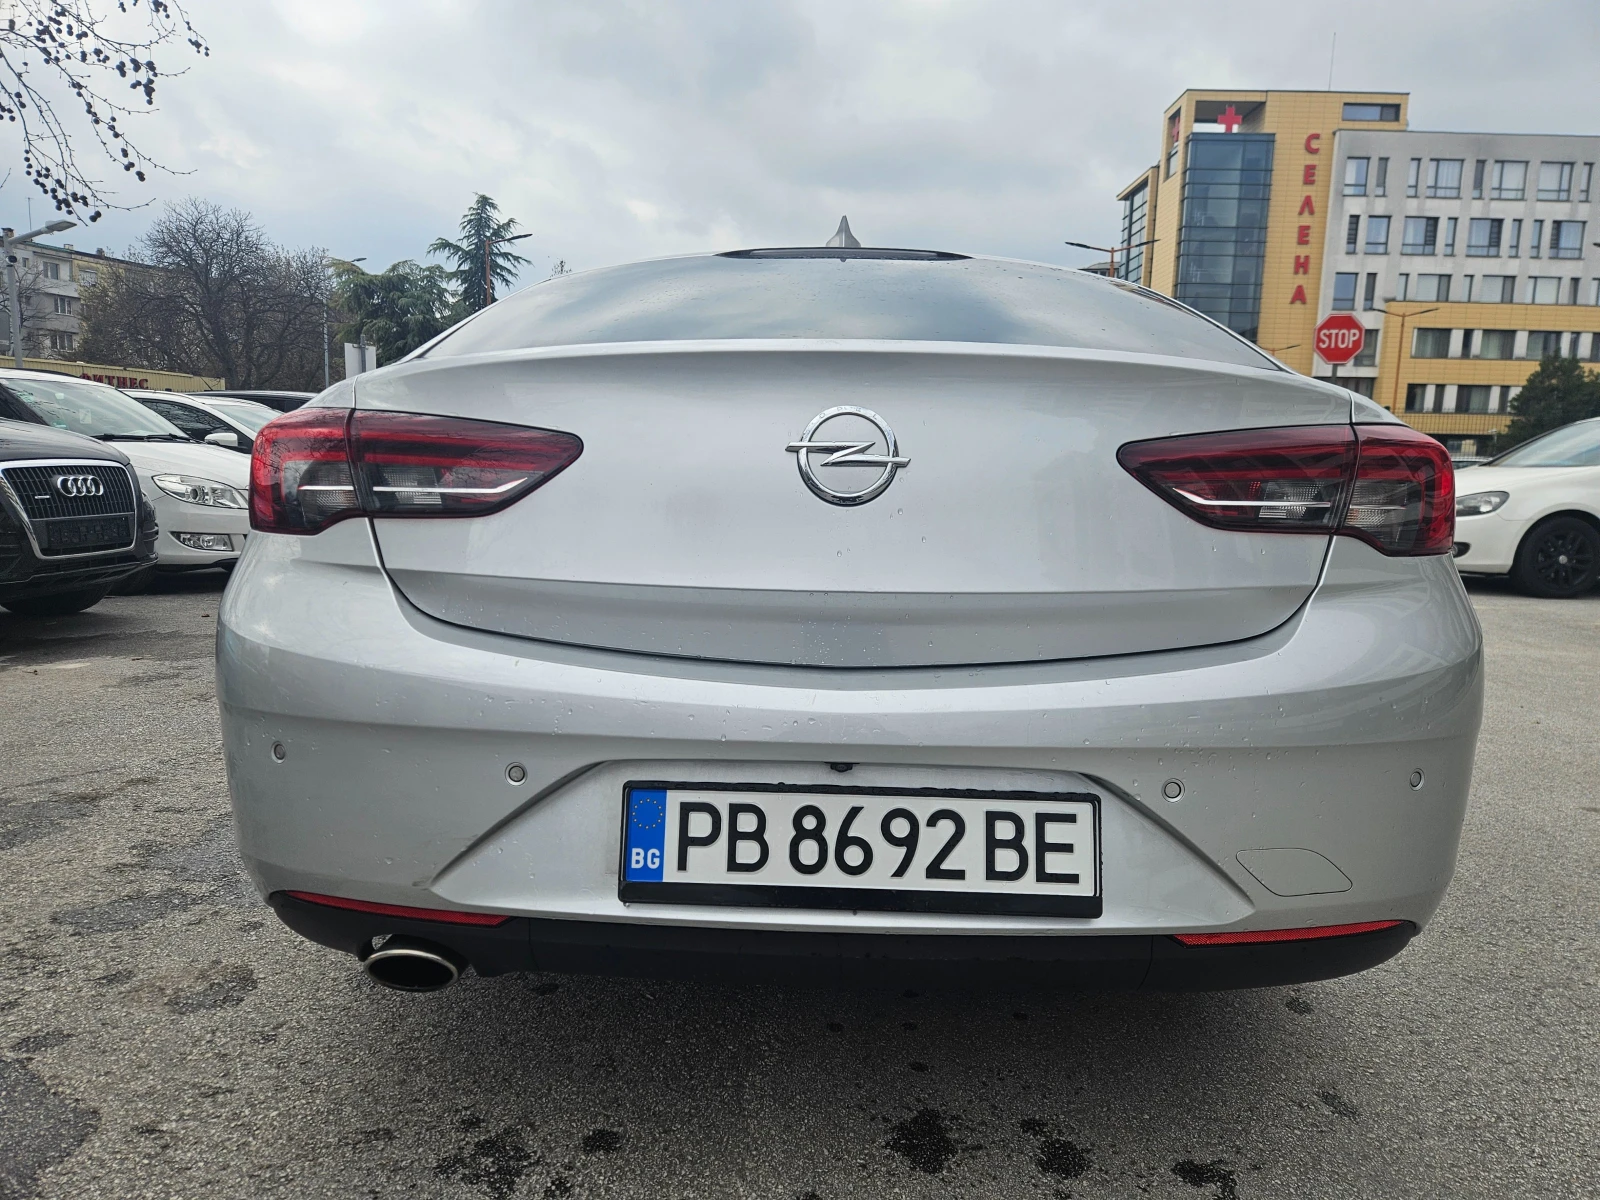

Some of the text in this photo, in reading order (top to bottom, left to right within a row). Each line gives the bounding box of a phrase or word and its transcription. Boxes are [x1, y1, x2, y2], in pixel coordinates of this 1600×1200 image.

[1289, 133, 1321, 305] СЕЛЕНА
[1319, 328, 1360, 349] STOP
[630, 847, 661, 870] BG
[677, 801, 1080, 883] PB 8692 BE
